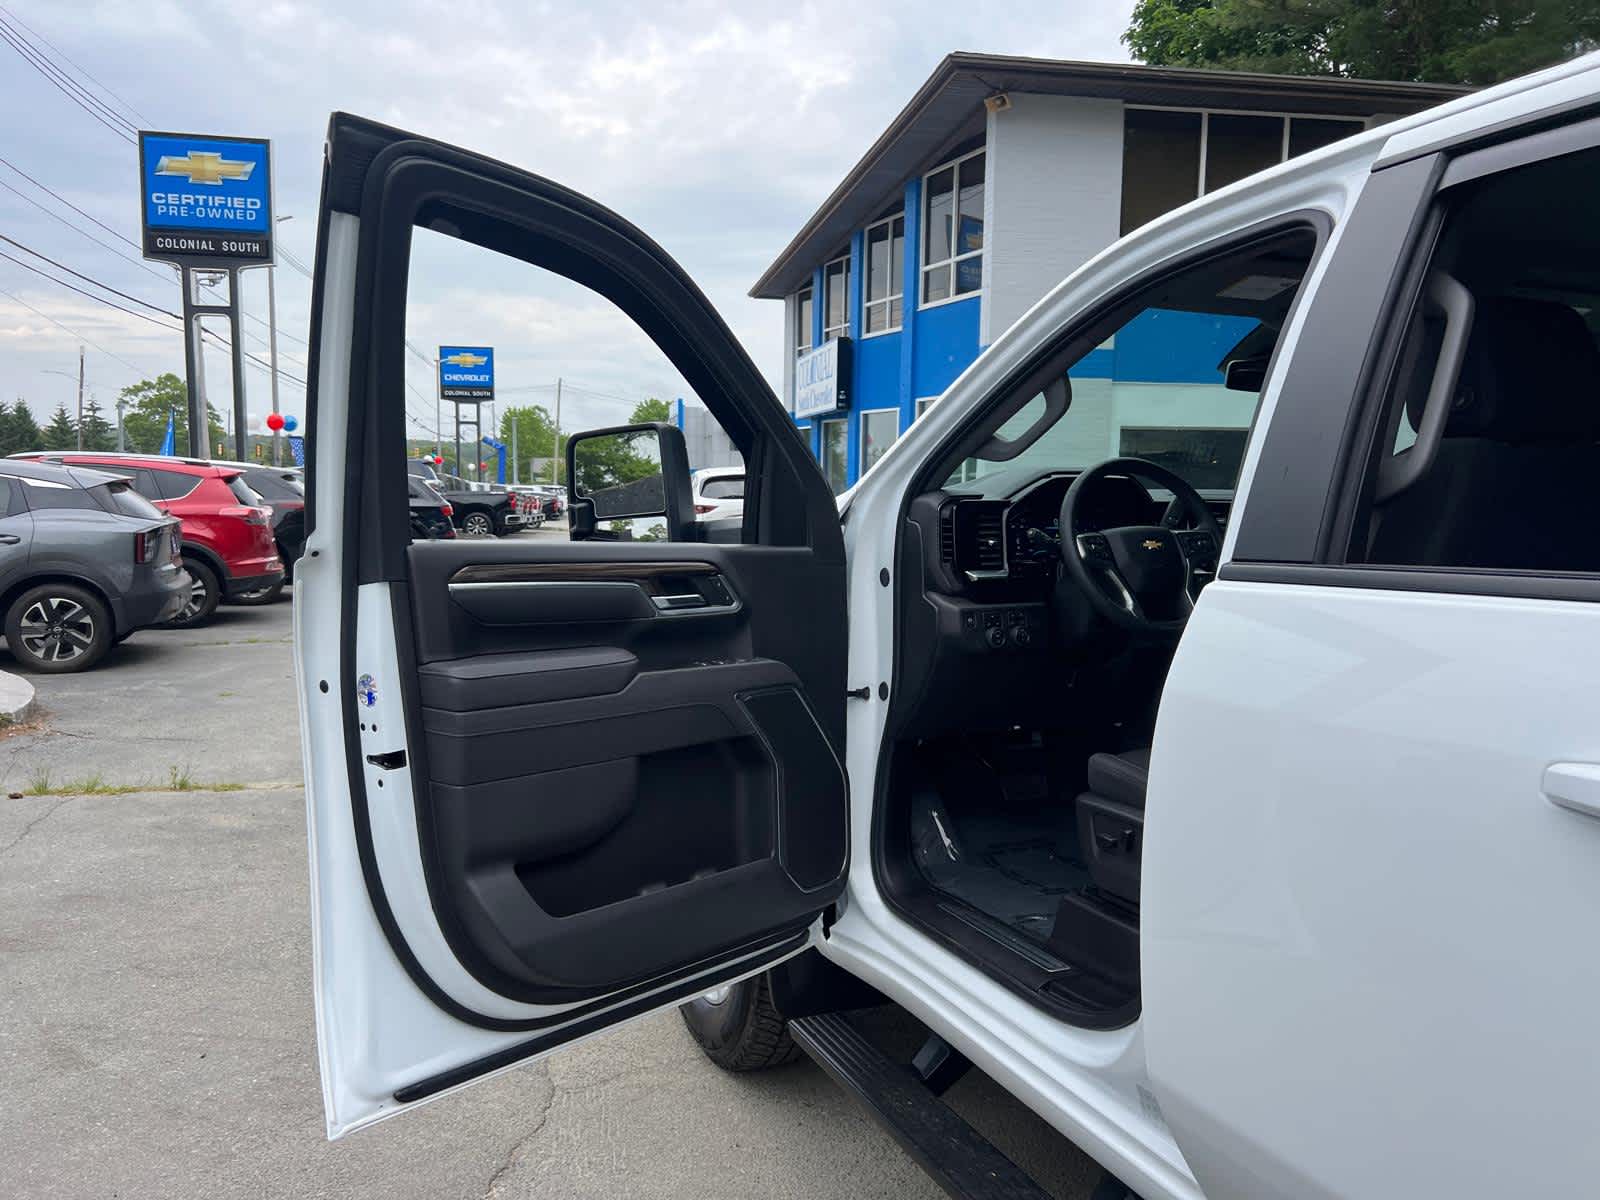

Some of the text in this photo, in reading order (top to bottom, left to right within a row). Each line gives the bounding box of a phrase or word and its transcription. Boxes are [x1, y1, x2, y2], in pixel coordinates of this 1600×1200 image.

[151, 192, 261, 209] CERTIFIED
[158, 205, 256, 220] PRE-OWNED
[156, 237, 260, 253] COLONIAL SOUTH
